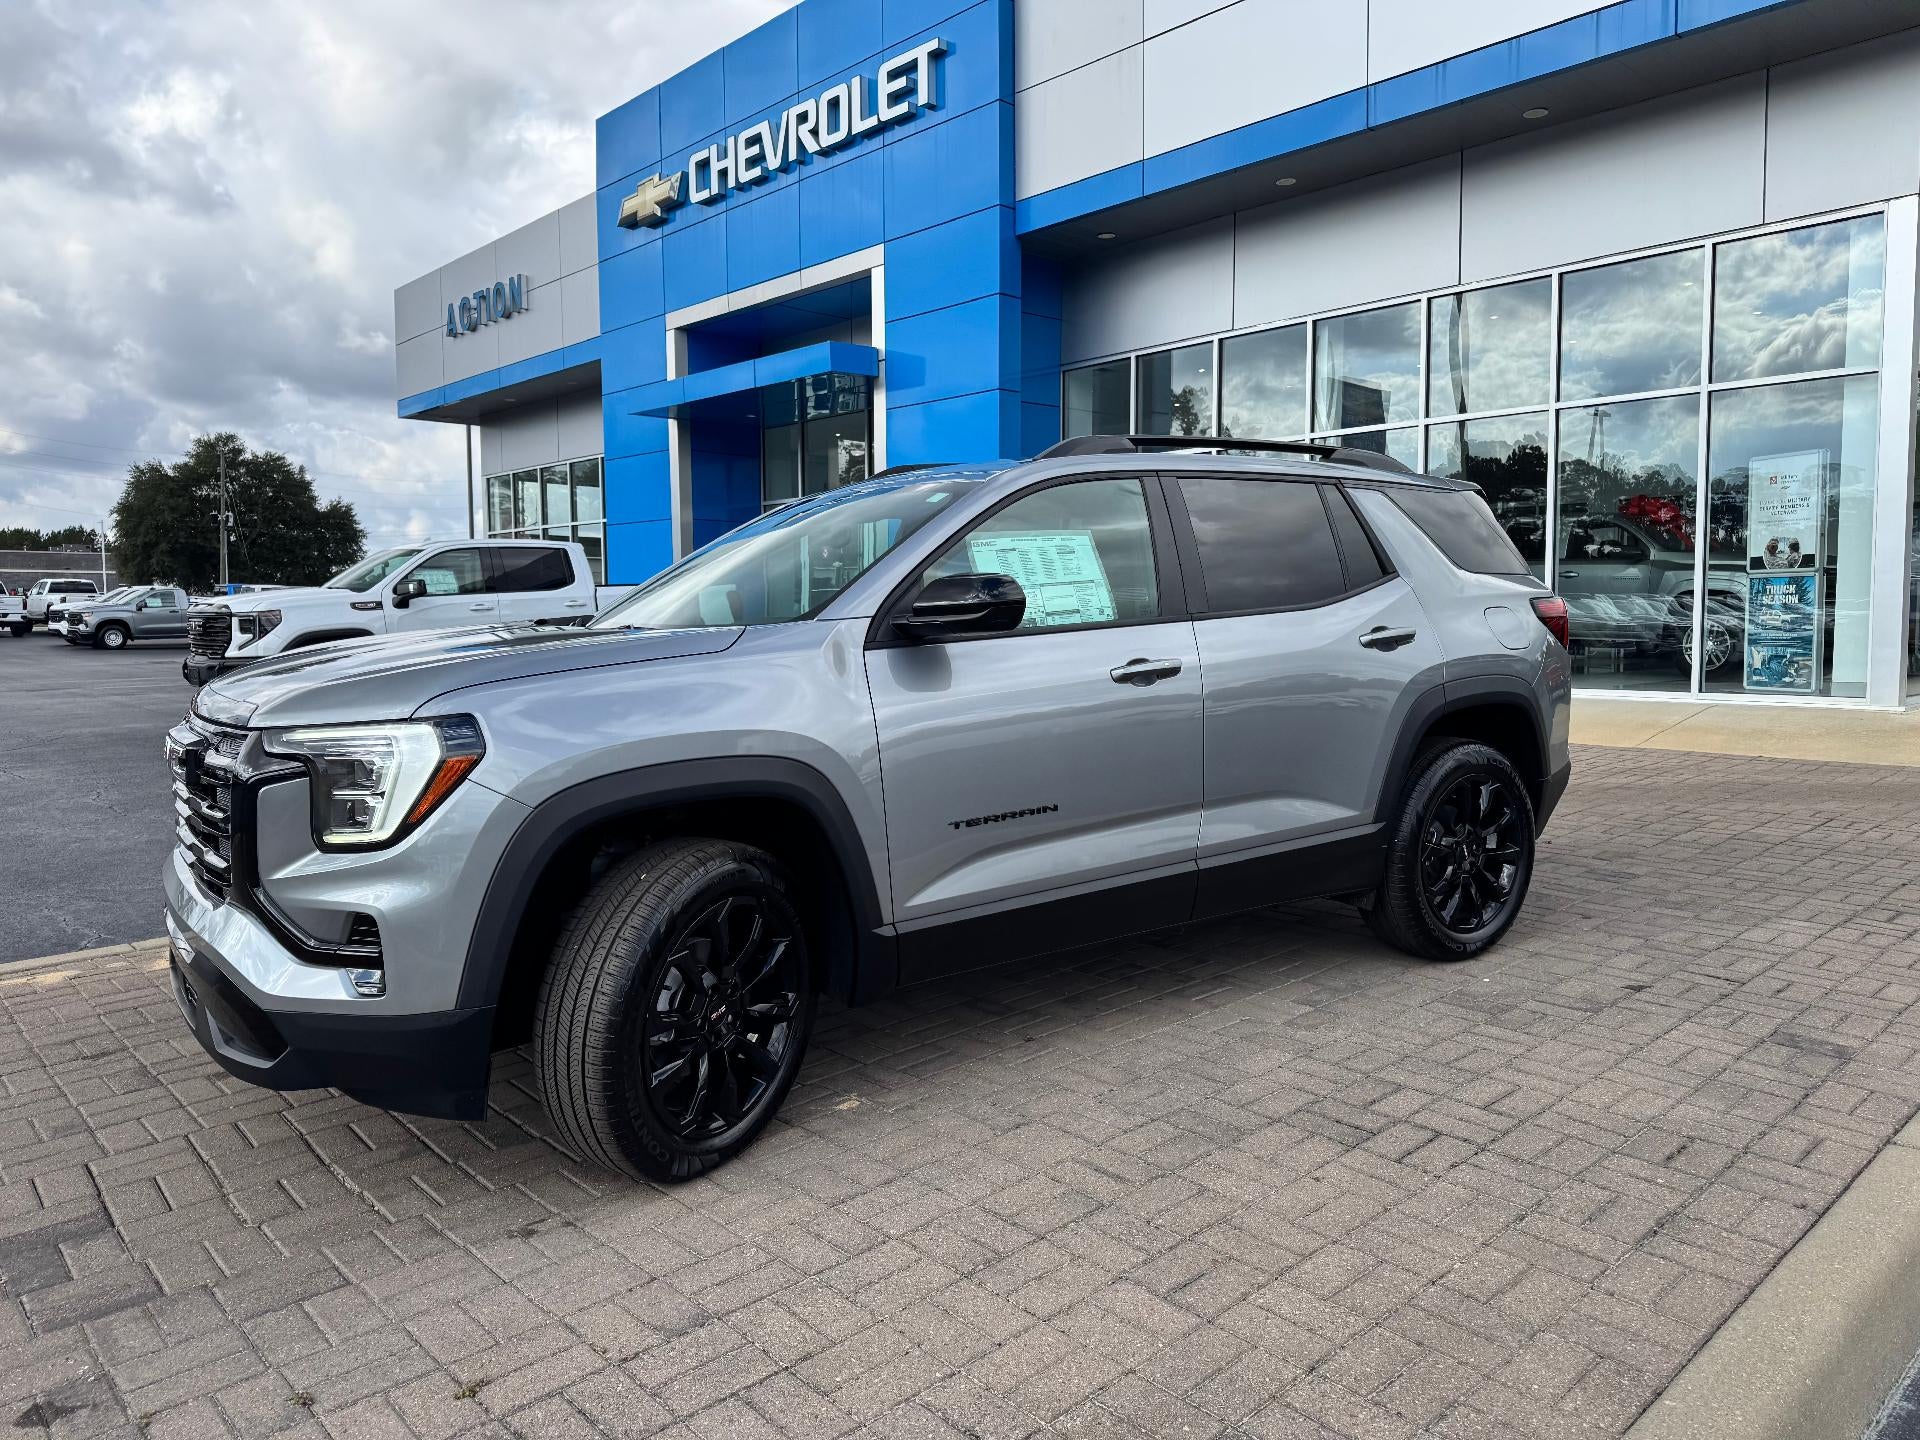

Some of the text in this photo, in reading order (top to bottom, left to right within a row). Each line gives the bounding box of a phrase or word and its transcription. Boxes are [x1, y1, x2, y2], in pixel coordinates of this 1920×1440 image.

[688, 37, 946, 205] CHEVROLET
[446, 273, 528, 337] ACTION
[1762, 594, 1799, 605] SEASON
[1765, 584, 1797, 595] TRUCK
[947, 803, 1059, 830] TERRAIN
